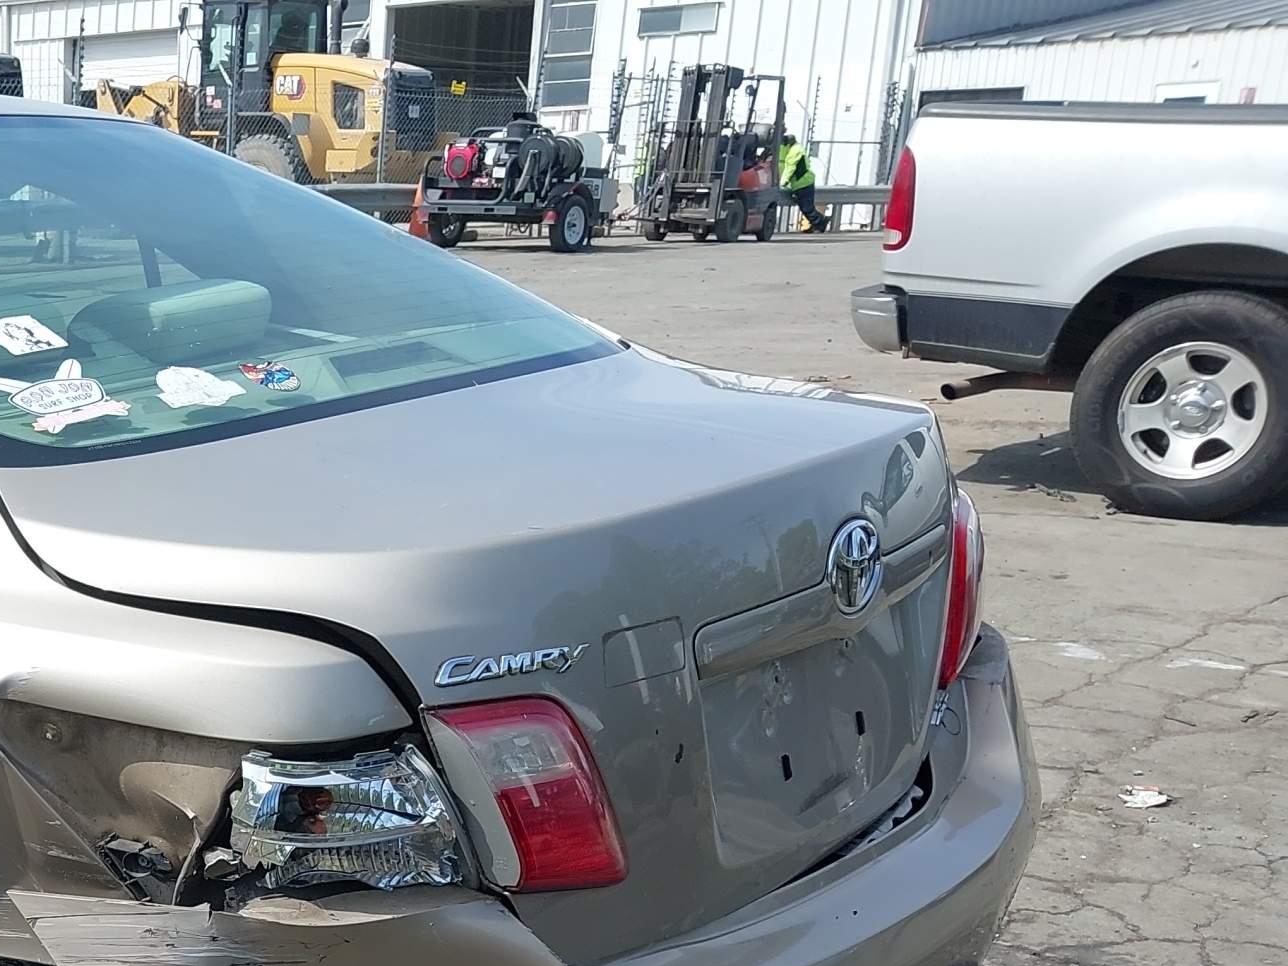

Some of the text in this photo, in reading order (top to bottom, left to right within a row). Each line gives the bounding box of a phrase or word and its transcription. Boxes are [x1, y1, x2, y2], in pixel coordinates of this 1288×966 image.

[275, 75, 300, 95] CAT
[38, 392, 93, 410] SURF SHOP
[434, 643, 590, 687] CAMRY
